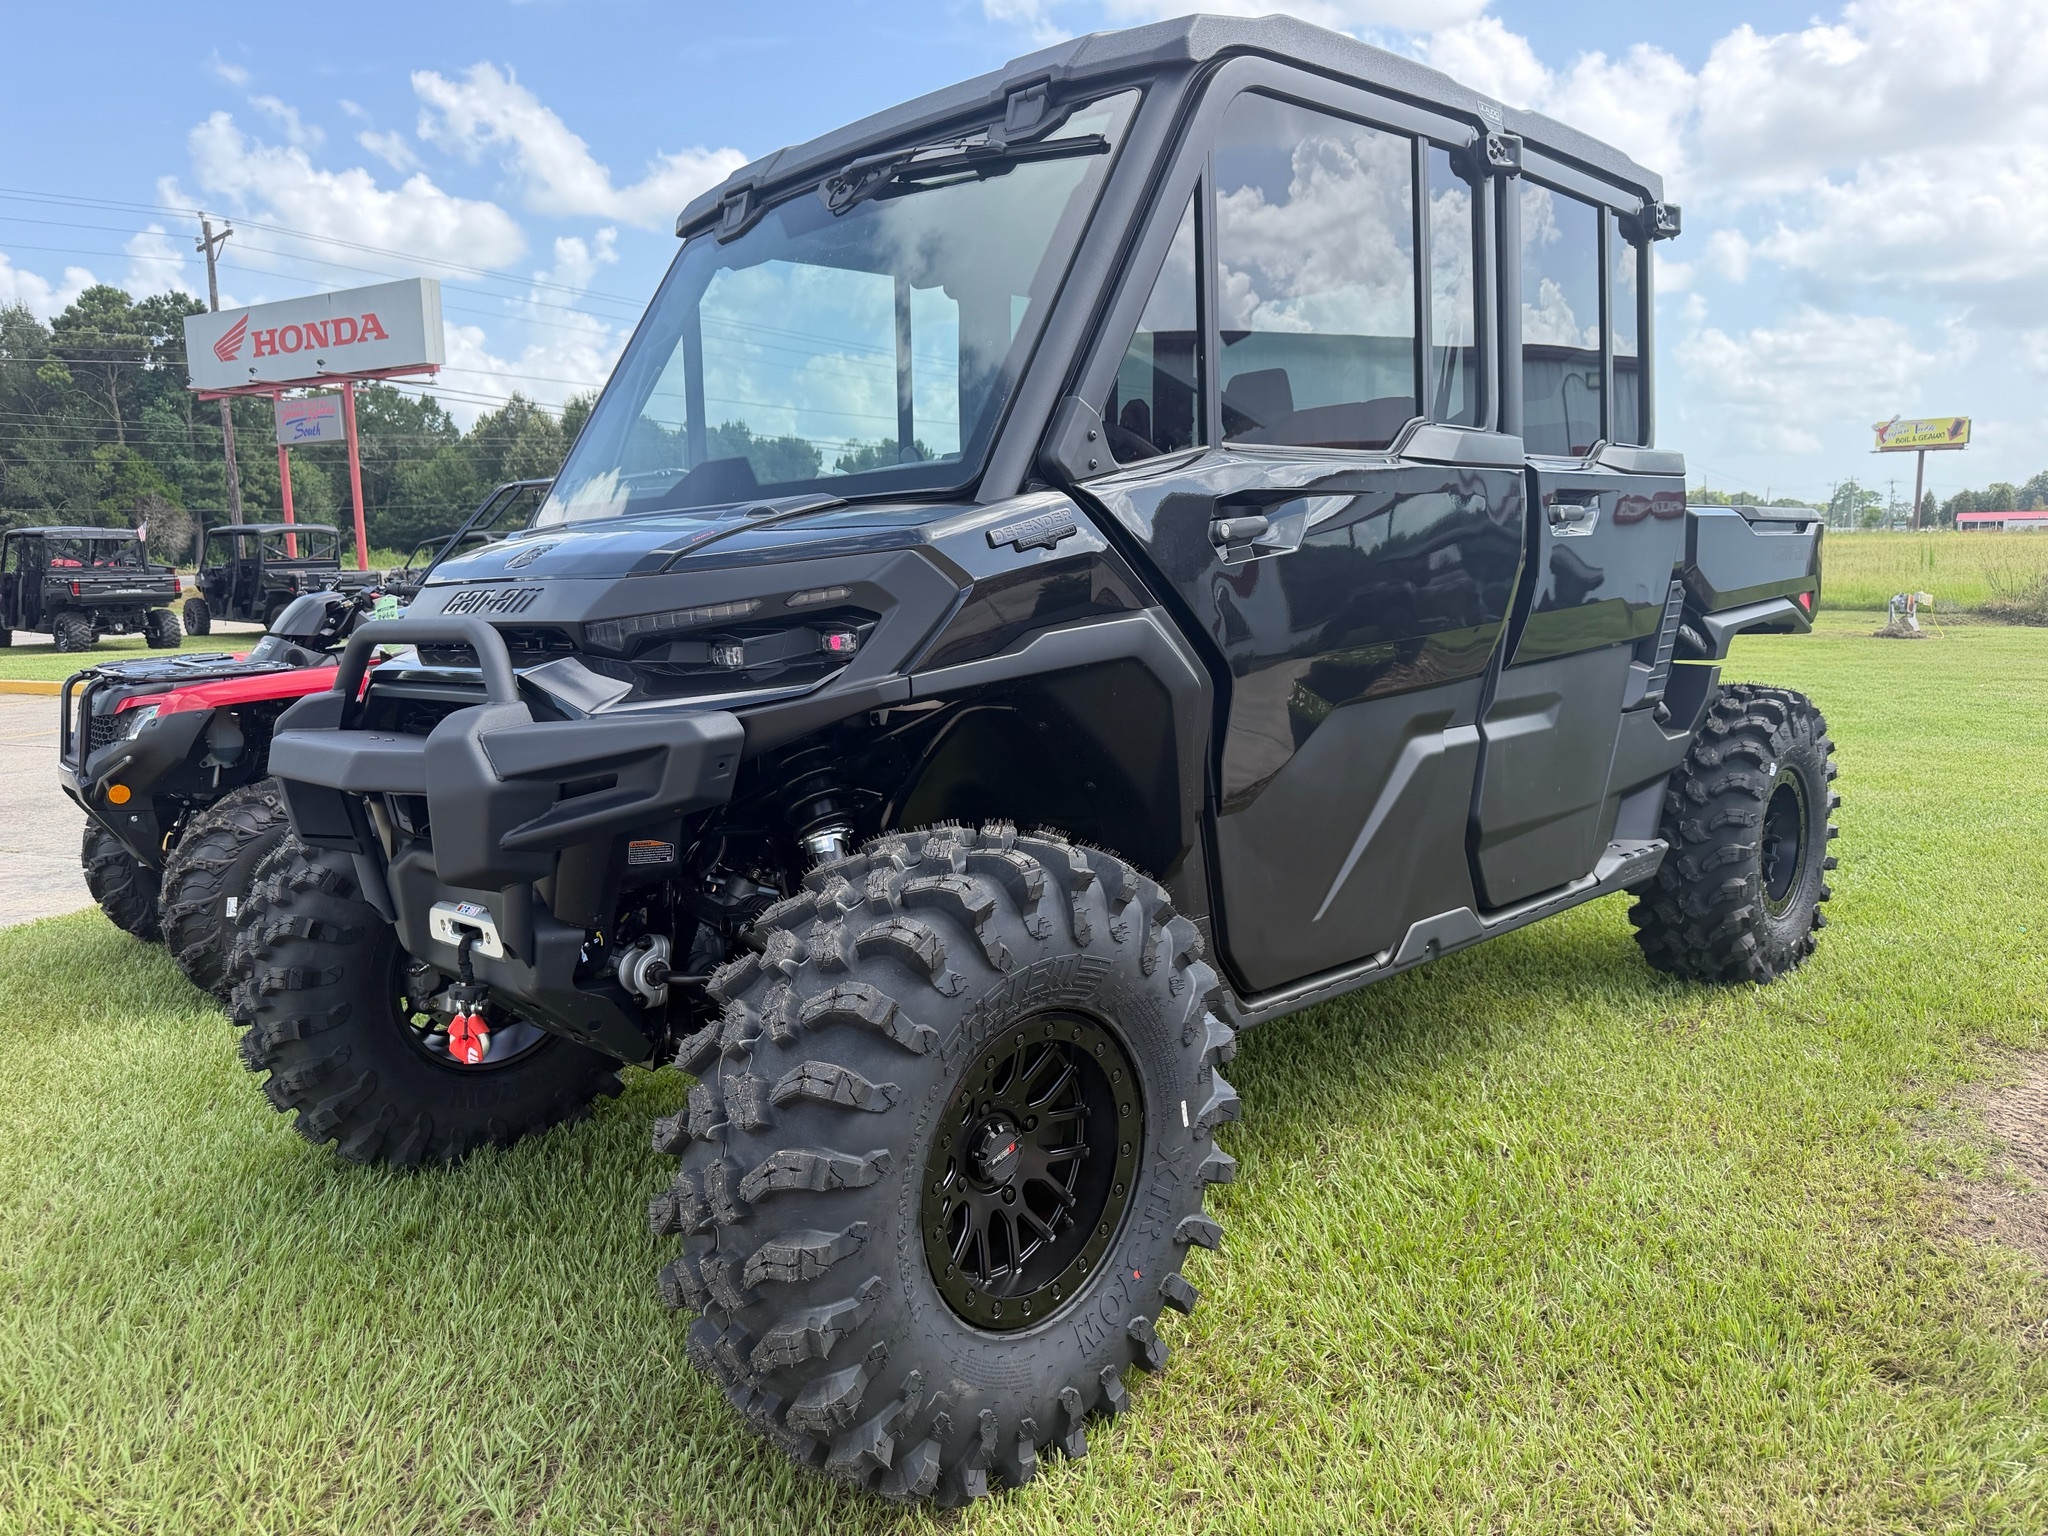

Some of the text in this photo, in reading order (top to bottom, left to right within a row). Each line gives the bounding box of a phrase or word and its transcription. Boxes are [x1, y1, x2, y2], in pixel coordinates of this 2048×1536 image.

[251, 313, 389, 358] HONDA
[294, 421, 321, 440] South
[1895, 436, 1911, 444] BOIL
[992, 509, 1073, 541] DEFENDER
[1021, 536, 1041, 547] LONE
